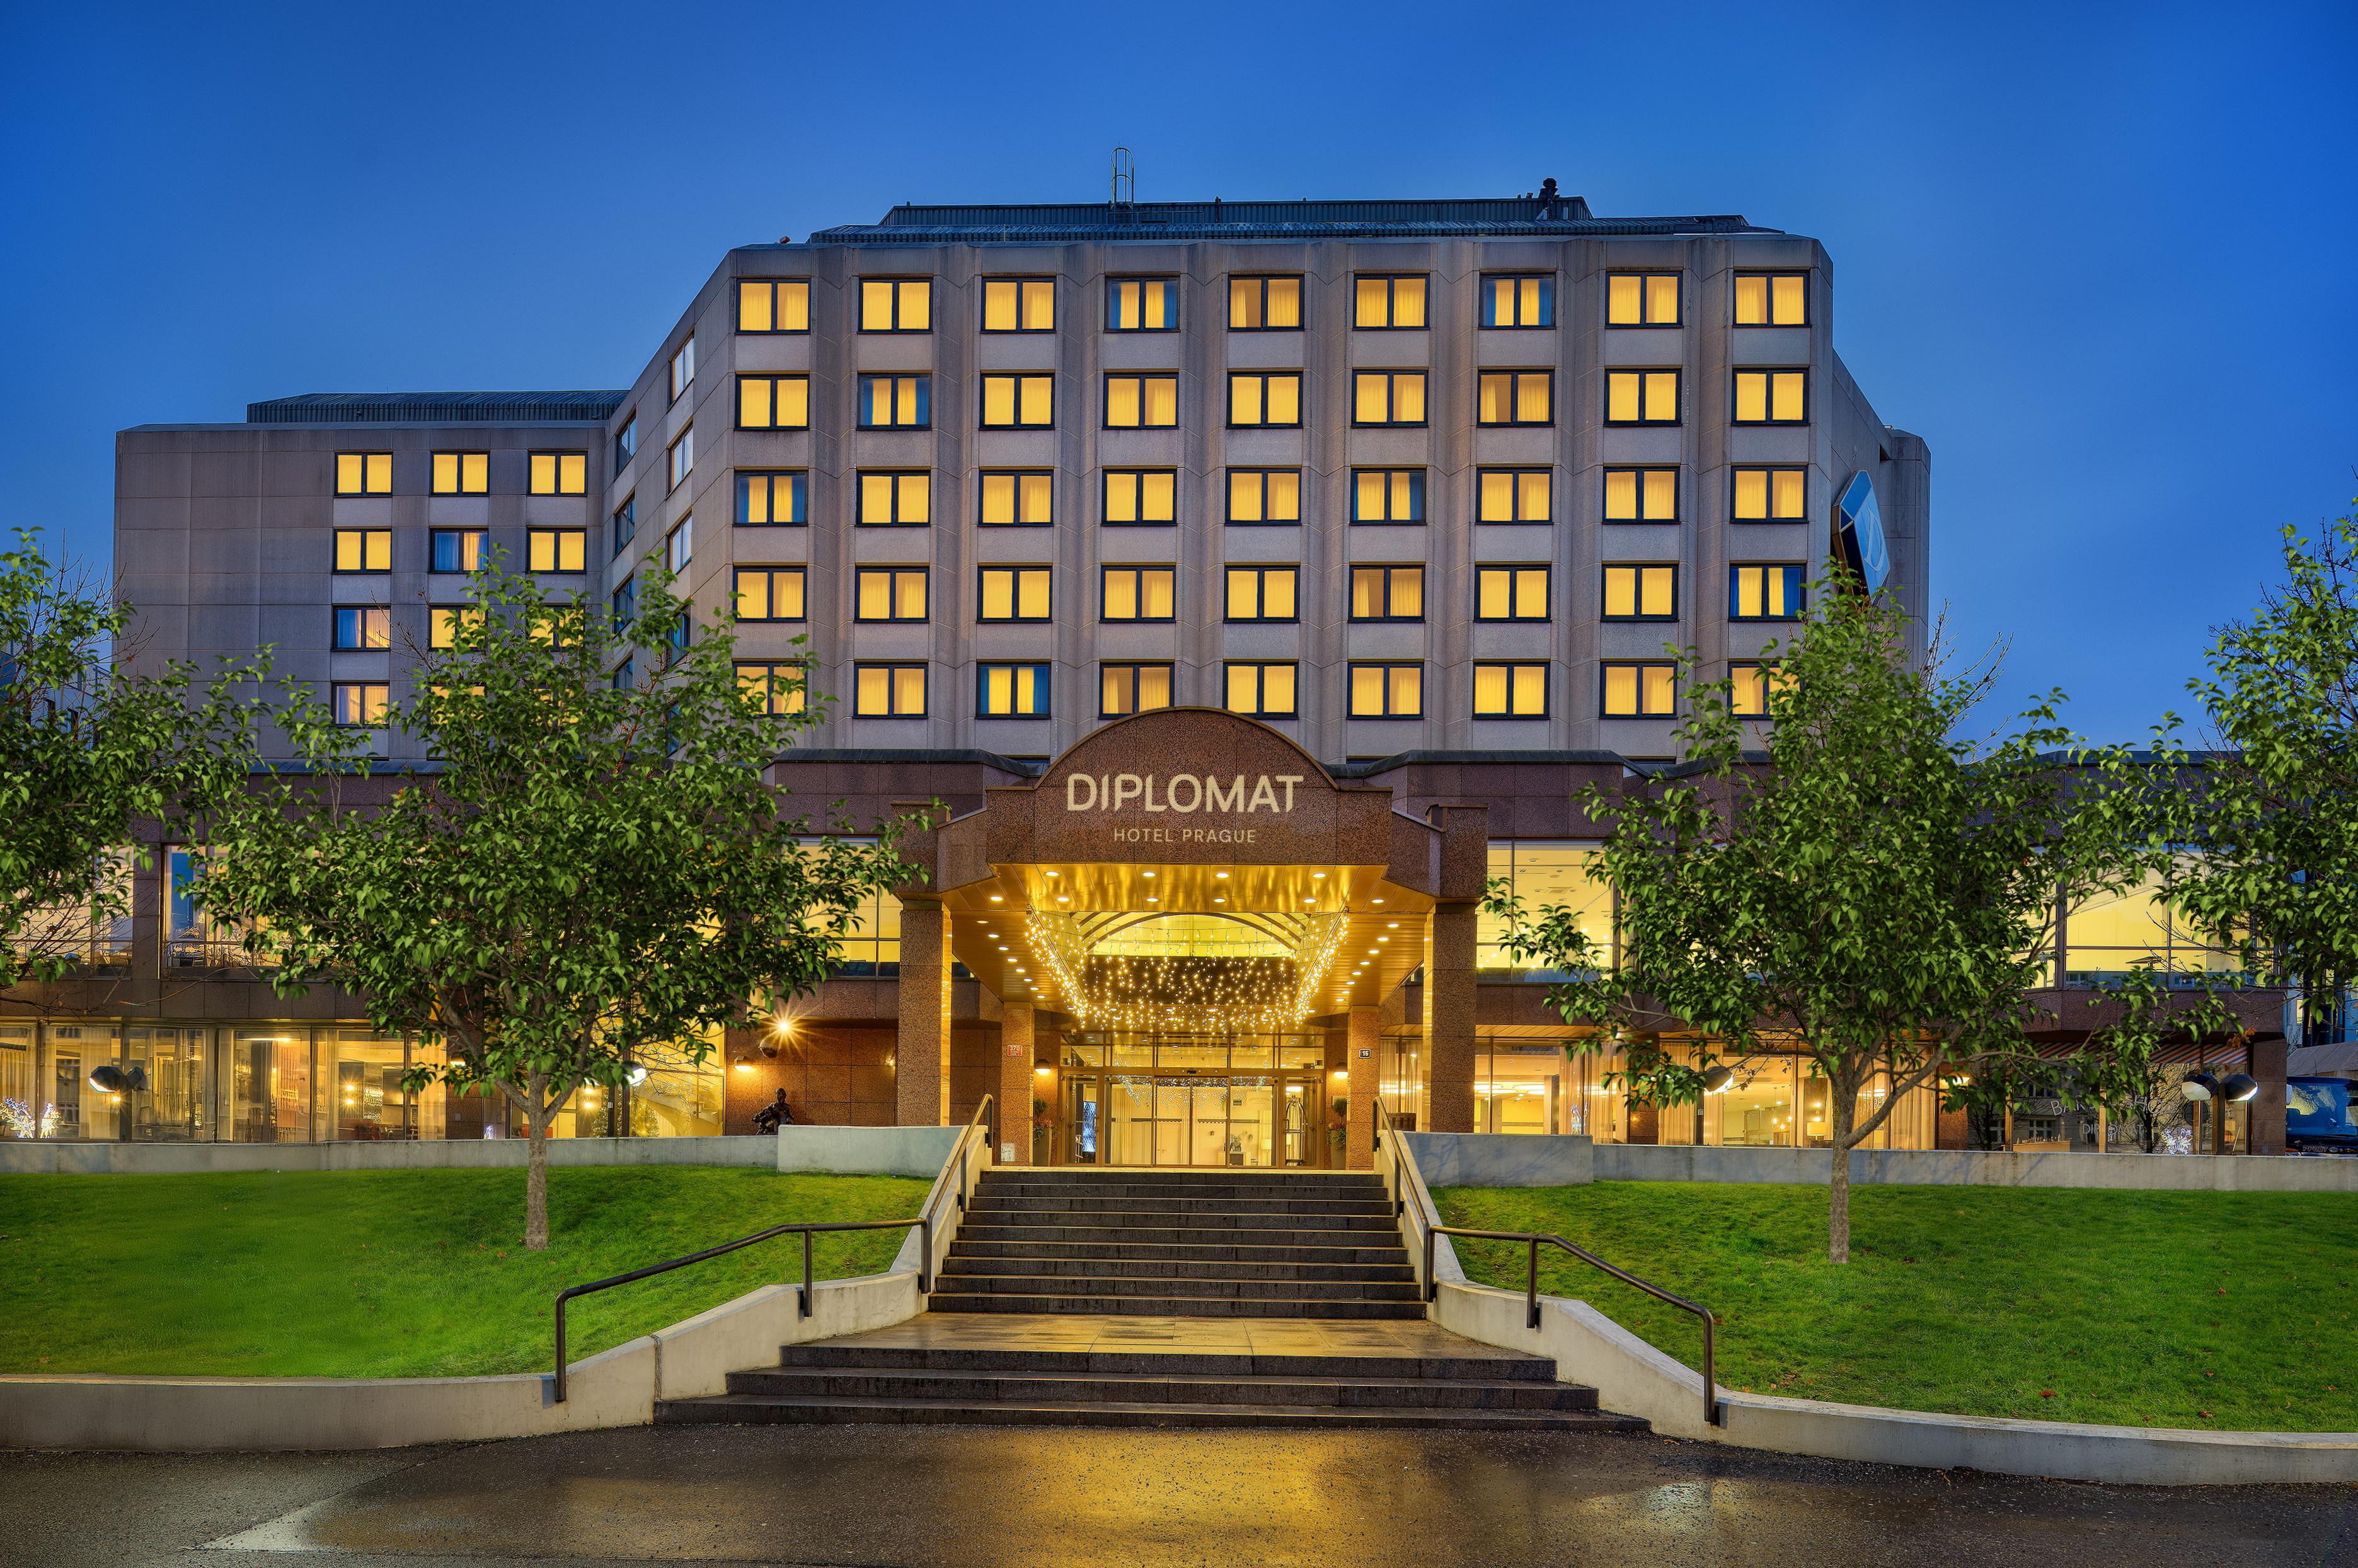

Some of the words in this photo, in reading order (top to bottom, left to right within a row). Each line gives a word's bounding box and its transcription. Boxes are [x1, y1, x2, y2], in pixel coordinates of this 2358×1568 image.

[1067, 774, 1304, 813] DIPLOMAT
[1113, 828, 1173, 843] HOTEL
[1182, 829, 1256, 843] PRAGUE
[2083, 1123, 2144, 1135] DIPOMAT
